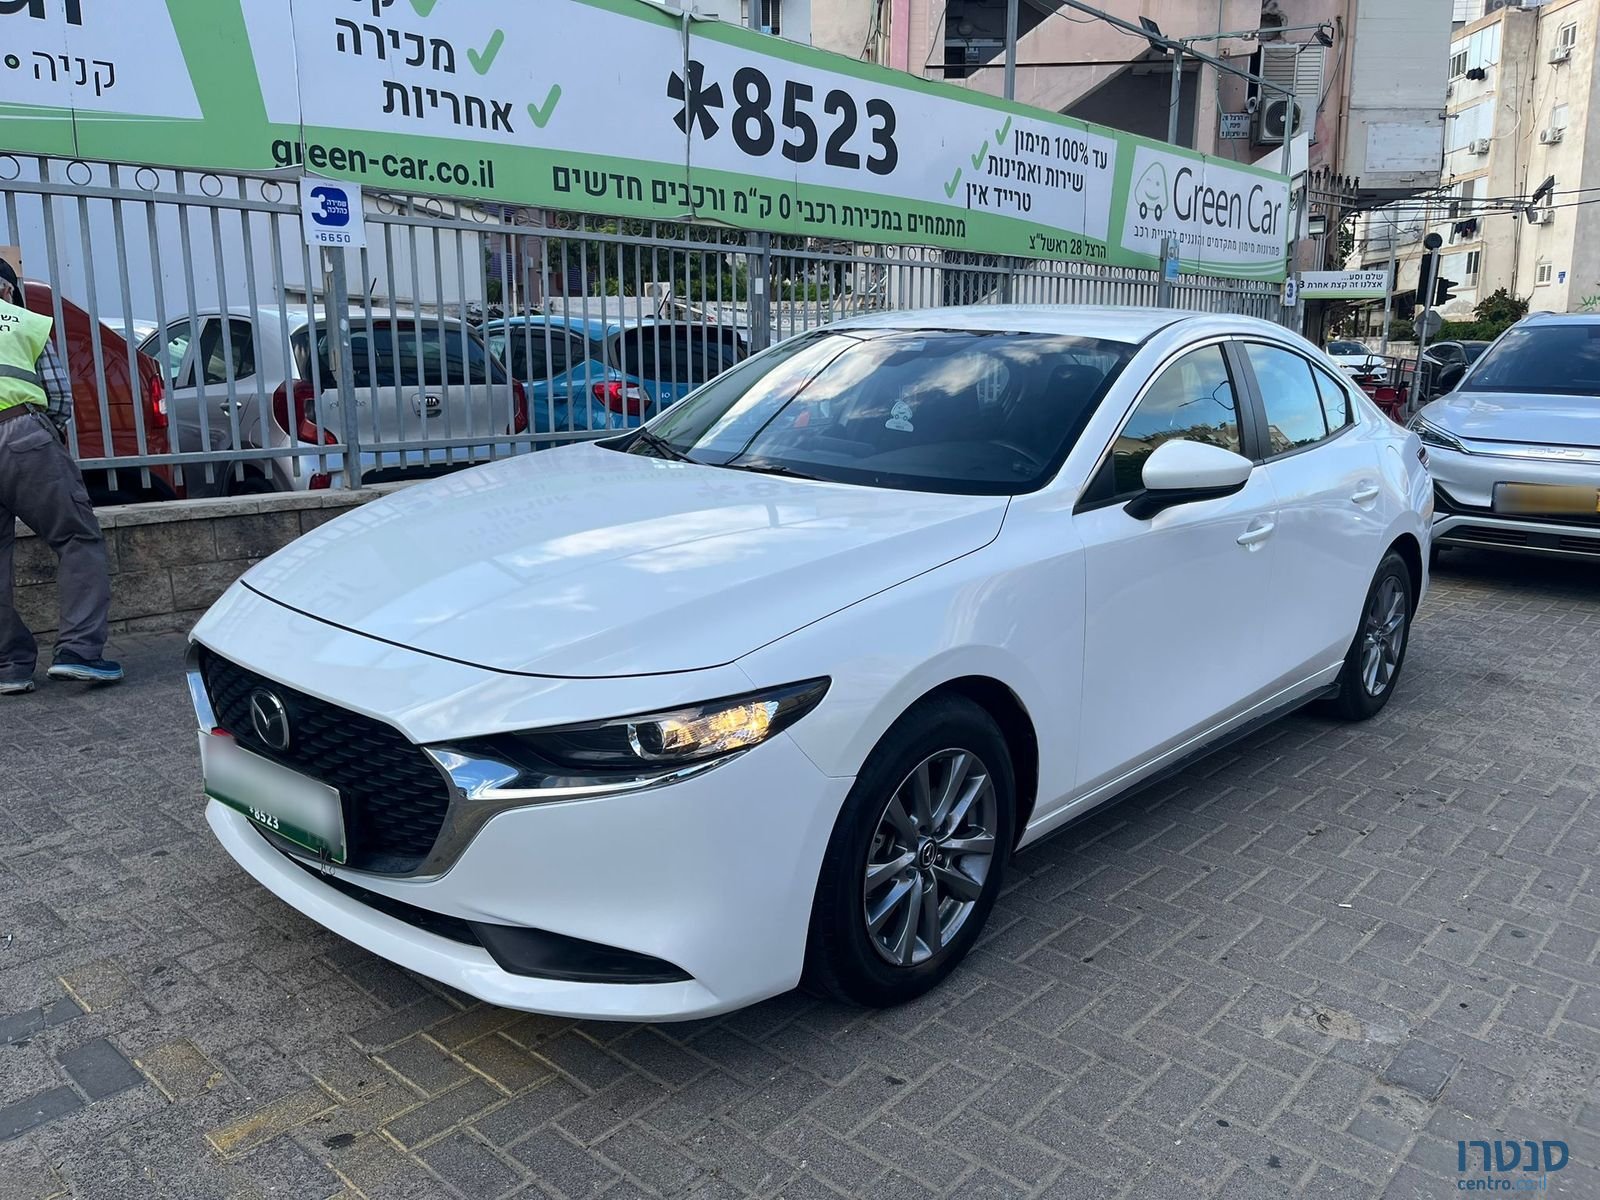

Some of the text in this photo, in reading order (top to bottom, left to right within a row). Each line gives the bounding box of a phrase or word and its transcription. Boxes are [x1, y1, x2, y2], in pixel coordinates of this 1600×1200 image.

[335, 17, 456, 74] מכירה
[32, 51, 115, 97] קניה
[382, 80, 514, 134] אחריות
[1014, 129, 1108, 170] עד 100% מימון
[271, 138, 495, 189] green-car.co.il
[987, 155, 1084, 192] שירות ואמינות
[552, 166, 643, 201] חדשים
[651, 179, 726, 212] ורכבים
[779, 193, 791, 220] 0
[966, 182, 1032, 212] טרייד אין
[1173, 166, 1282, 236] Green Car
[796, 200, 837, 225] רכבי
[841, 205, 903, 231] במכירת
[907, 213, 966, 238] מתמחים
[1133, 225, 1149, 240] רכב
[1070, 238, 1082, 255] 28
[1085, 240, 1107, 259] הרצל
[1307, 281, 1329, 289] אחרת
[1330, 281, 1347, 290] קצת
[1349, 280, 1358, 288] זה
[1360, 280, 1383, 288] אצלנו
[1365, 273, 1384, 281] שלם
